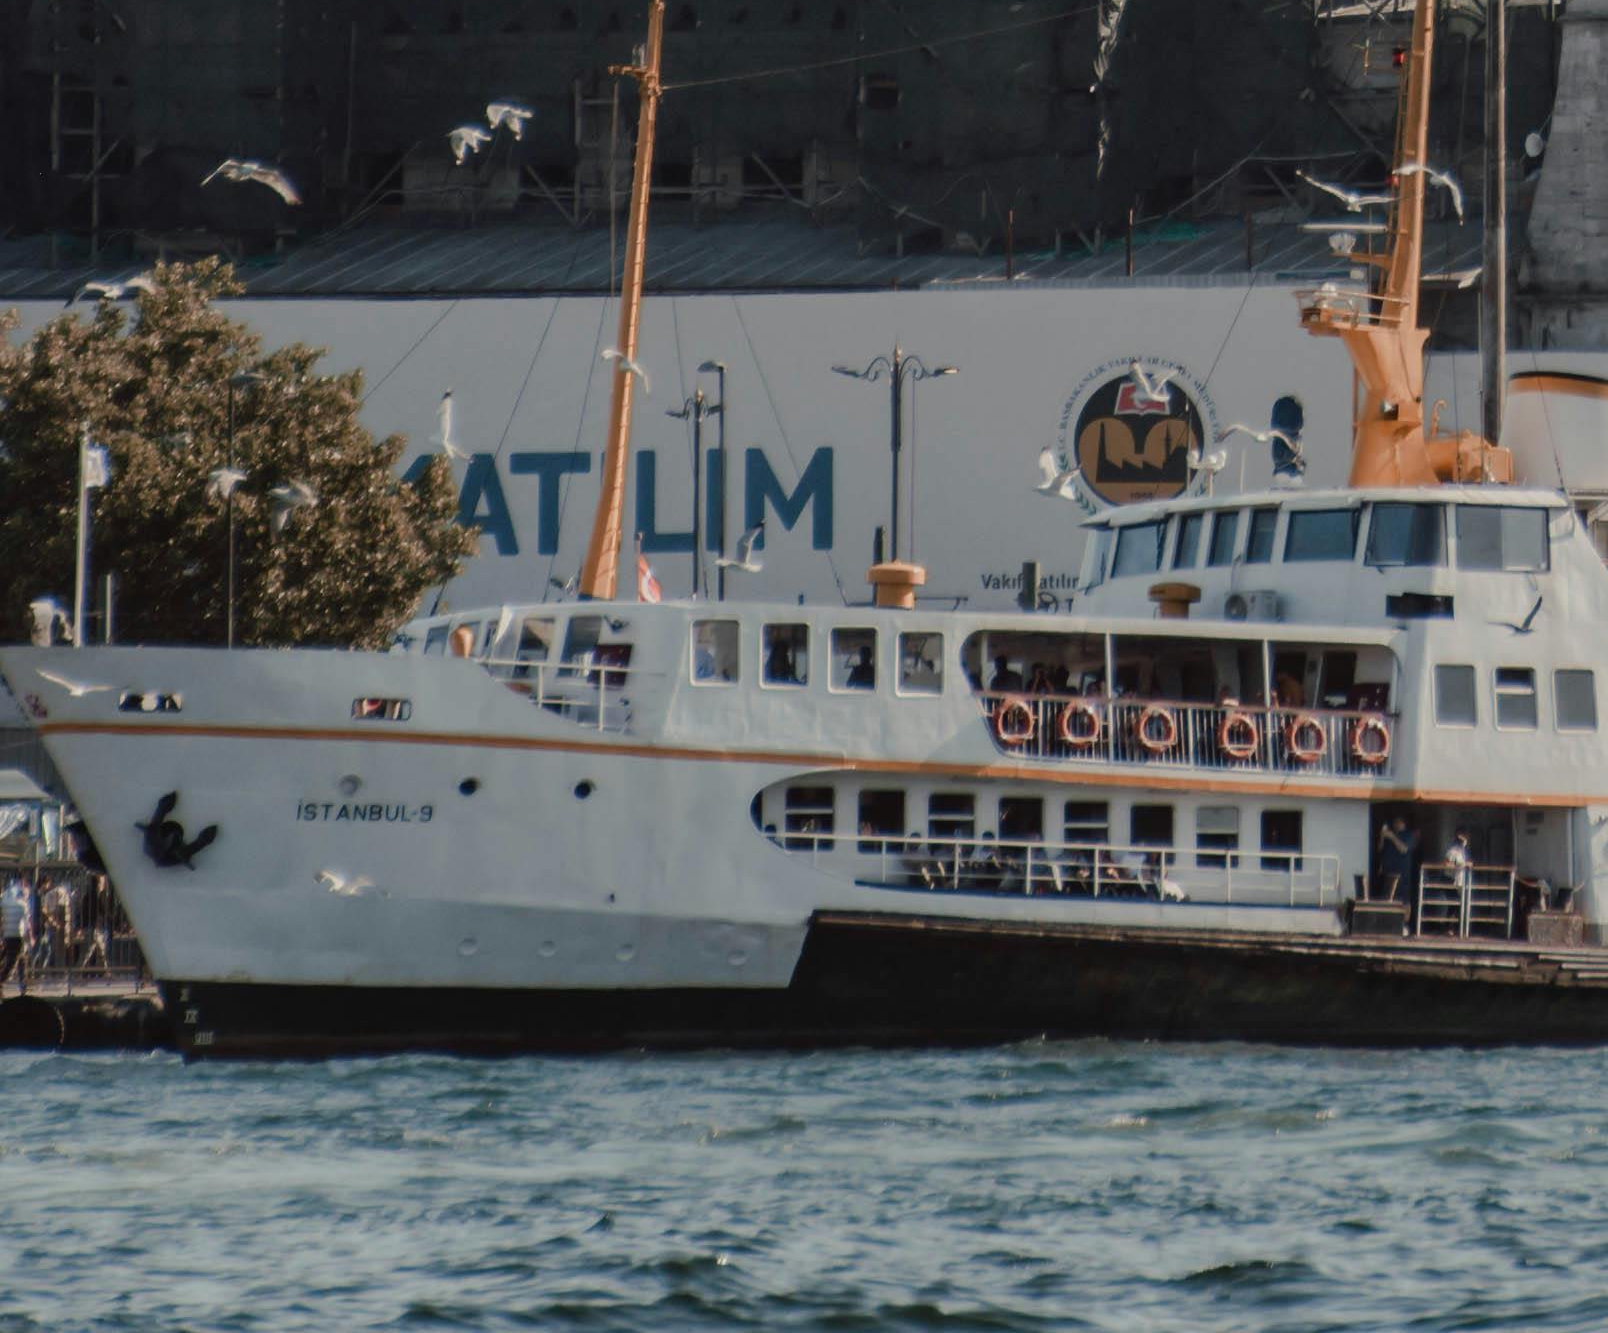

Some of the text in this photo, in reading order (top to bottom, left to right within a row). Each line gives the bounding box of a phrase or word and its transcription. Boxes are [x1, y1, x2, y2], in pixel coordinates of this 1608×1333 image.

[402, 446, 834, 556] ATLIM
[981, 573, 1079, 590] Vakıf atılı
[296, 798, 434, 822] İSTANBUL-9
